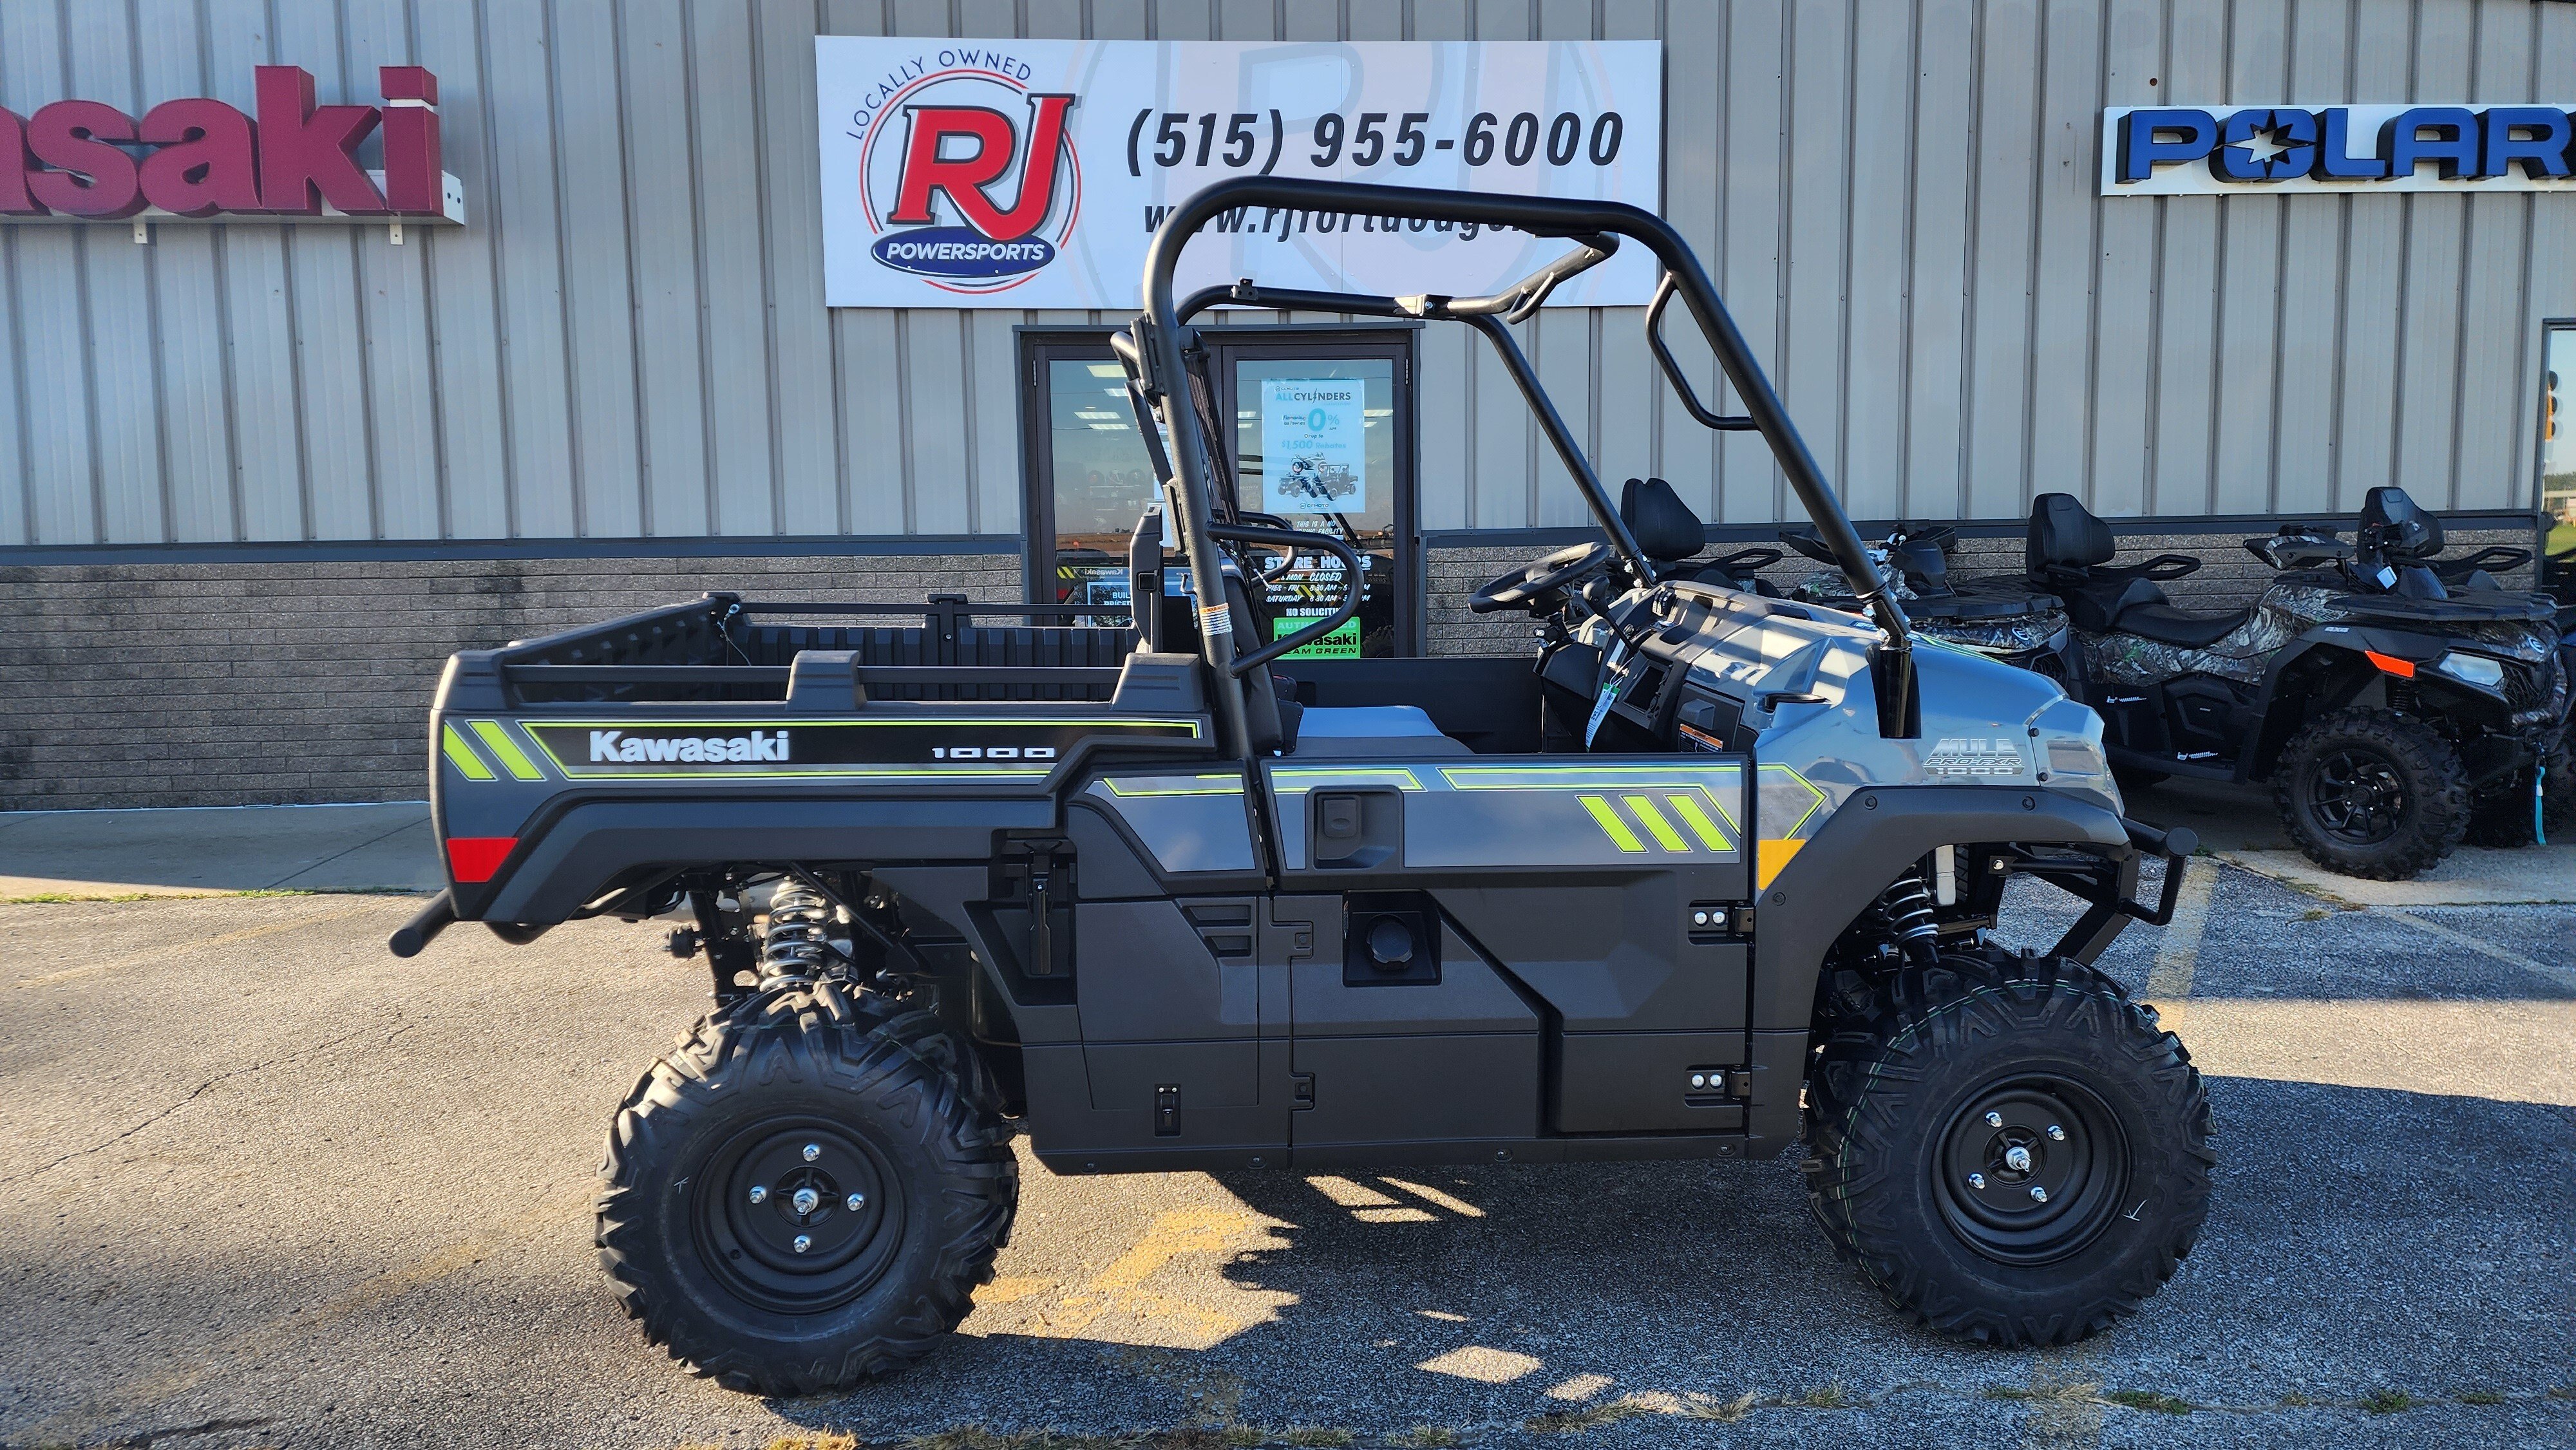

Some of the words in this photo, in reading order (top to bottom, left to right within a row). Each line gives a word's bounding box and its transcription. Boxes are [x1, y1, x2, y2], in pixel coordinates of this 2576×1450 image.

[846, 56, 923, 140] LOCALLY
[938, 48, 1031, 81] OWNED
[0, 65, 444, 218] saki
[1127, 108, 1284, 176] (515)
[1310, 112, 1623, 167] 955-6000
[886, 93, 1077, 242] RJ
[886, 243, 1045, 260] POWERSPORTS
[1281, 440, 1313, 450] $1,500
[1264, 556, 1313, 569] STRE
[1320, 555, 1372, 569] HOS
[1309, 572, 1342, 581] CLOSED
[1286, 608, 1298, 616] NO
[1300, 607, 1341, 616] SOLICITI
[1277, 621, 1356, 629] AUTHD
[1277, 633, 1357, 646] asaki
[590, 730, 789, 762] Kawasaki
[931, 748, 1055, 758] 1000
[1929, 739, 2019, 757] MULE
[1924, 757, 2023, 766] PRO-FXR
